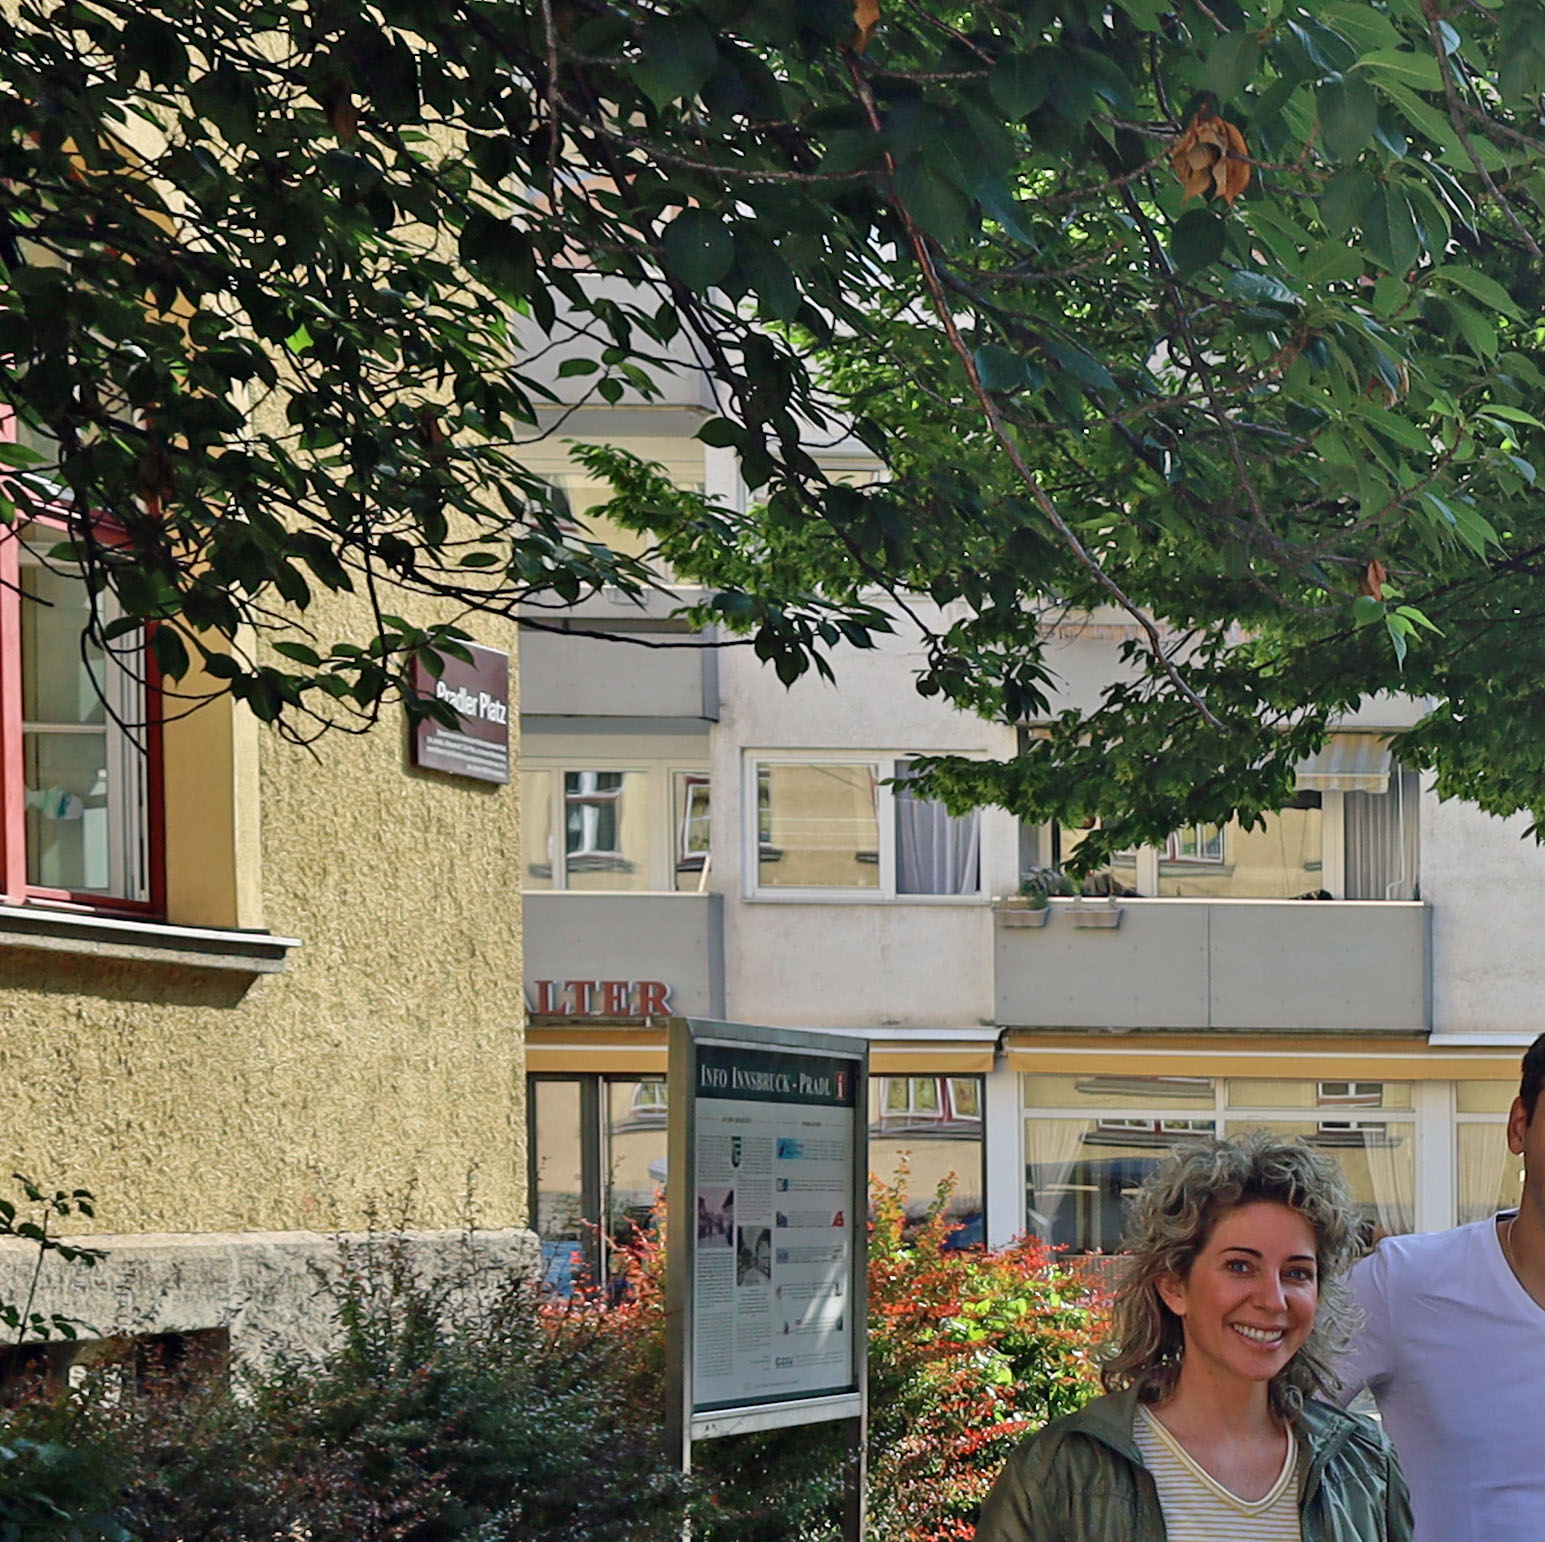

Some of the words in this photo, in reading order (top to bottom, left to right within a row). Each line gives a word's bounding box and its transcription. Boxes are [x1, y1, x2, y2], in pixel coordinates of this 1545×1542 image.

[479, 692, 507, 725] Platz
[524, 980, 673, 1017] LTER
[701, 1063, 728, 1089] INFO
[732, 1066, 790, 1093] INNSBRUCK
[799, 1072, 832, 1096] PRADL
